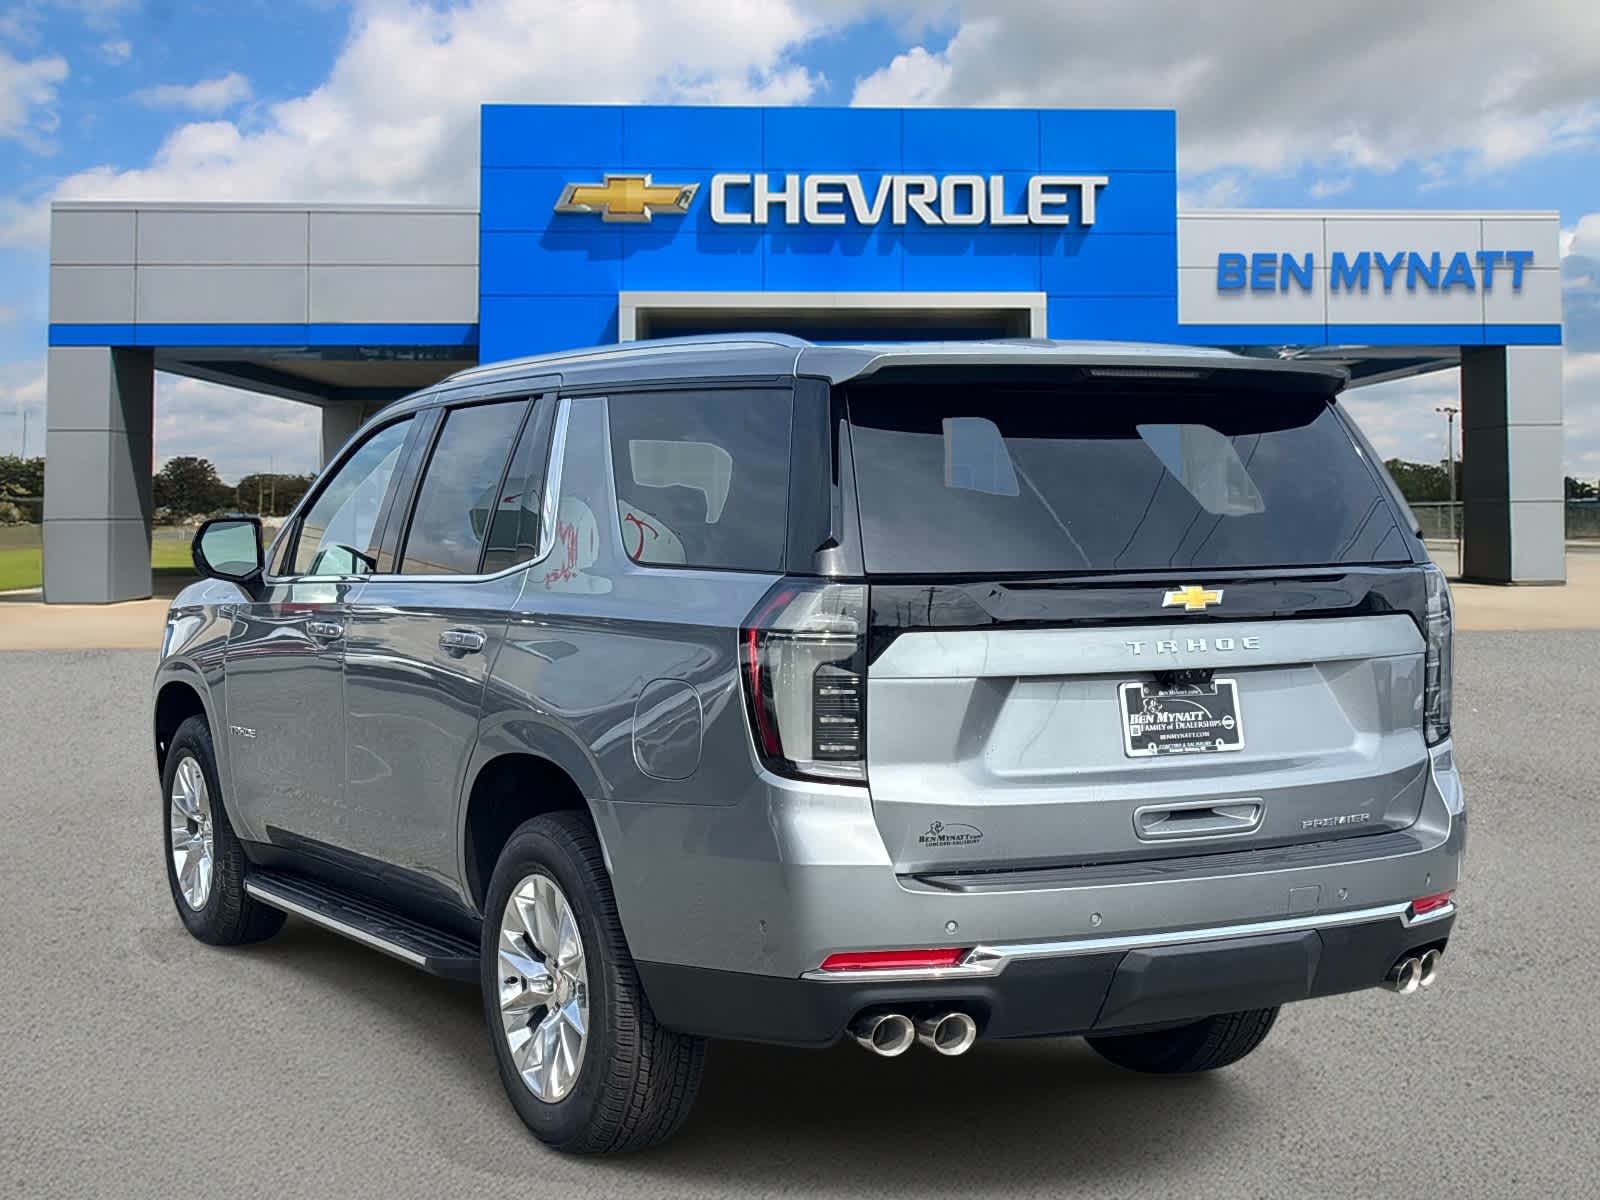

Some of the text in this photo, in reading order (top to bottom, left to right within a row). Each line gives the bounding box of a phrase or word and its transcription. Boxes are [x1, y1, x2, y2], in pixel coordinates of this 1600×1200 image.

[710, 173, 1109, 226] CHEVROLET
[1217, 250, 1534, 291] BEN MYNATT
[1126, 636, 1260, 656] TAHOE
[1130, 711, 1205, 724] BEN MYNATT
[1141, 723, 1166, 732] FAMILY
[1302, 813, 1369, 829] PREMIER
[919, 835, 936, 843] BEN
